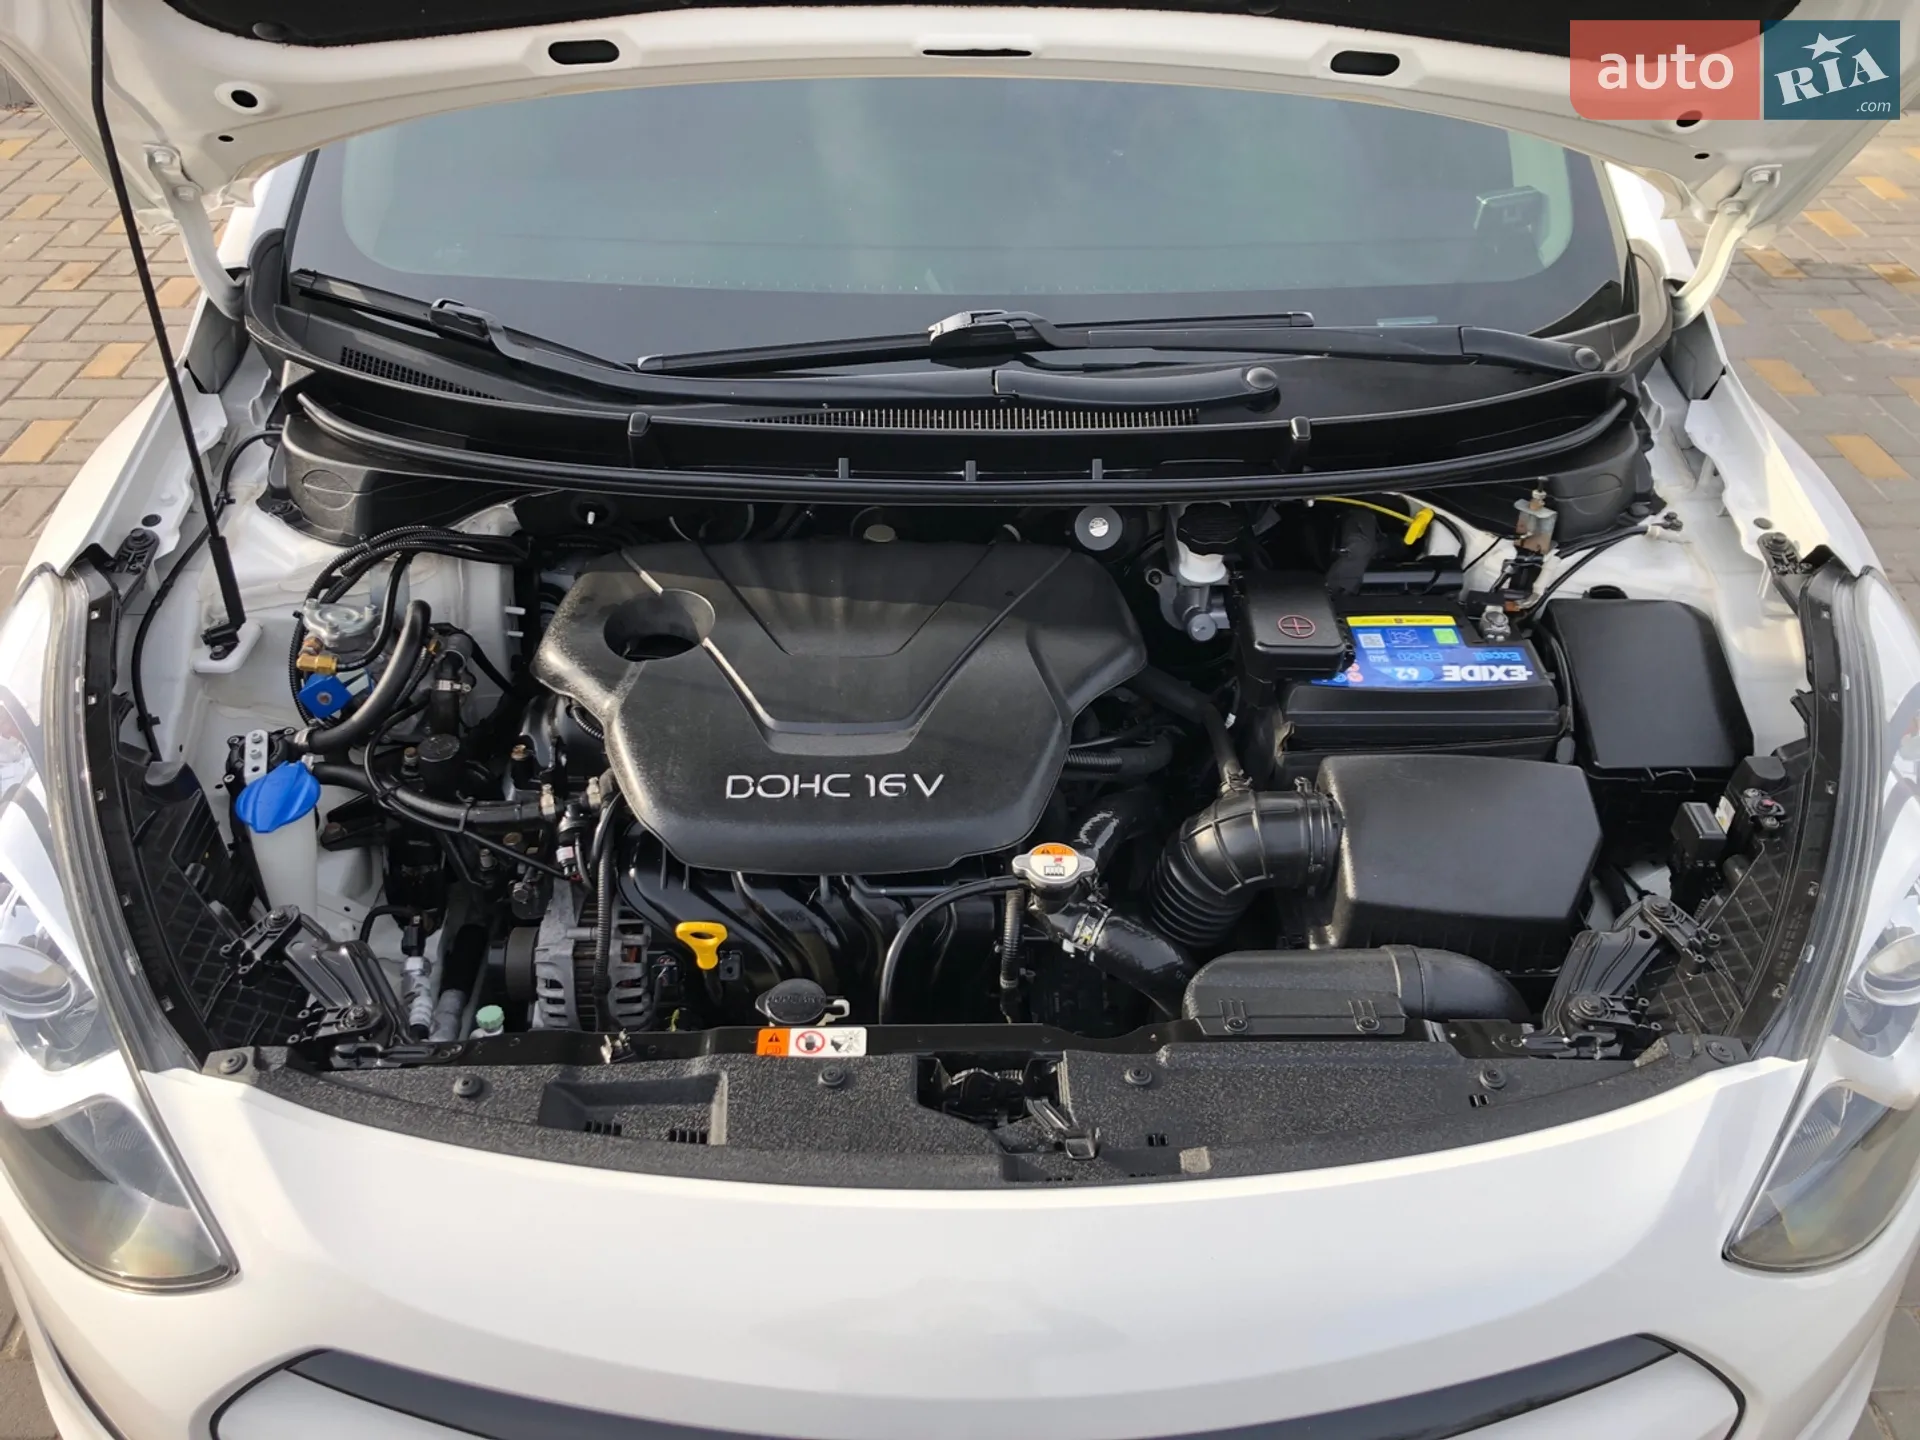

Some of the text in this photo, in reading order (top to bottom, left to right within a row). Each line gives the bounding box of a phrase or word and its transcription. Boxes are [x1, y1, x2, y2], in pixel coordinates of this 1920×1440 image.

[1394, 666, 1420, 681] 62
[1442, 664, 1532, 682] EXIDE
[725, 773, 851, 799] DOHC
